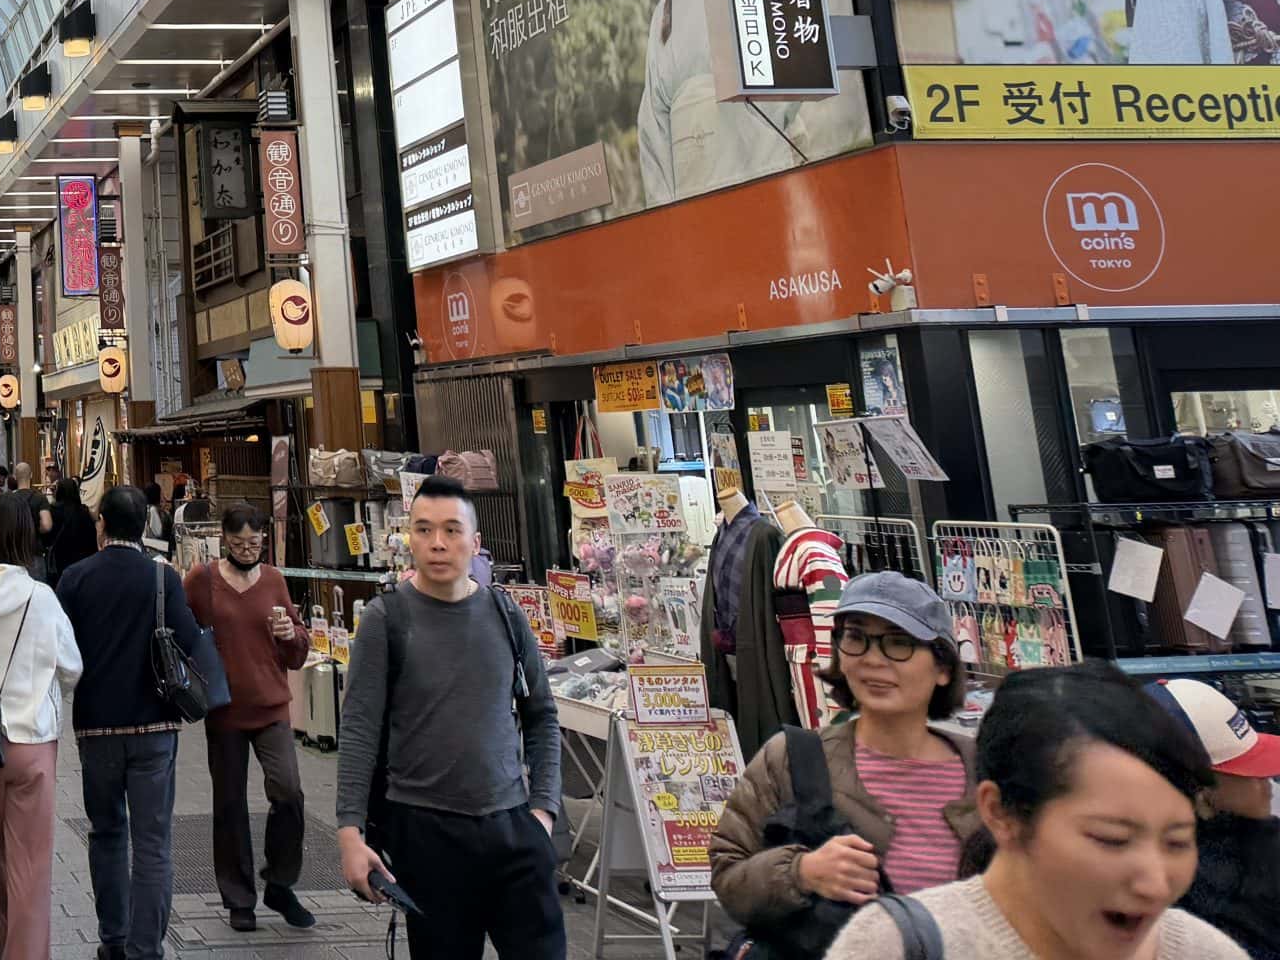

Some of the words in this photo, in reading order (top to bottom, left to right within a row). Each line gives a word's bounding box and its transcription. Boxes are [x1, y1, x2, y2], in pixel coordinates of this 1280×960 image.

[926, 85, 981, 123] 2F
[1002, 81, 1089, 126] 受付
[267, 140, 298, 245] 観音通り
[1089, 259, 1132, 269] TOKYO
[101, 253, 121, 323] 観音通り
[769, 269, 842, 302] ASAKUSA
[600, 371, 624, 383] OUTLET
[625, 368, 643, 381] SALE
[608, 478, 634, 492] SANRIO
[638, 676, 698, 686] きものレンタル
[638, 732, 723, 753] 浅草きもの
[660, 756, 728, 776] レンタル
